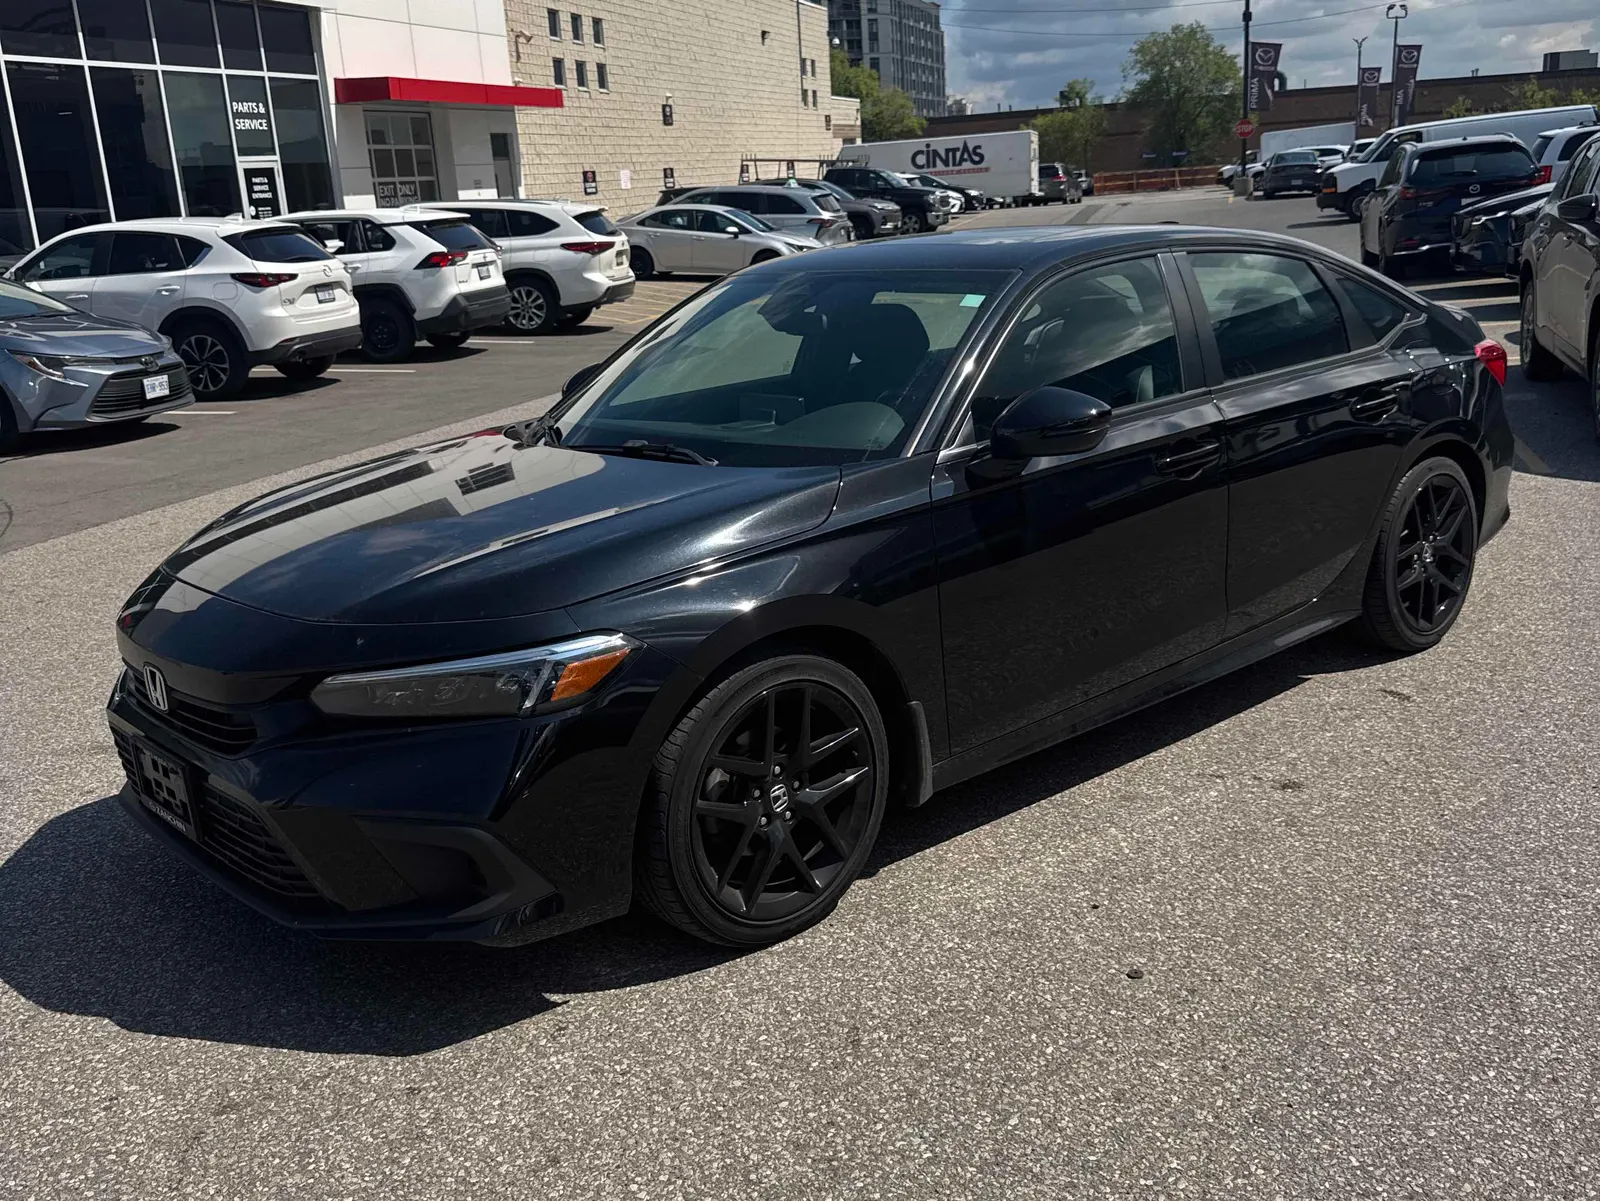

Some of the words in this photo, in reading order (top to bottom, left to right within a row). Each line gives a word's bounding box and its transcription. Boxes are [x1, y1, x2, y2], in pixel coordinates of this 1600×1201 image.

[1250, 78, 1260, 109] PRIMA
[232, 101, 258, 113] PARTS
[258, 102, 266, 113] &
[235, 118, 268, 130] SERVICE
[1236, 124, 1253, 133] STOP
[380, 185, 395, 197] EXIT
